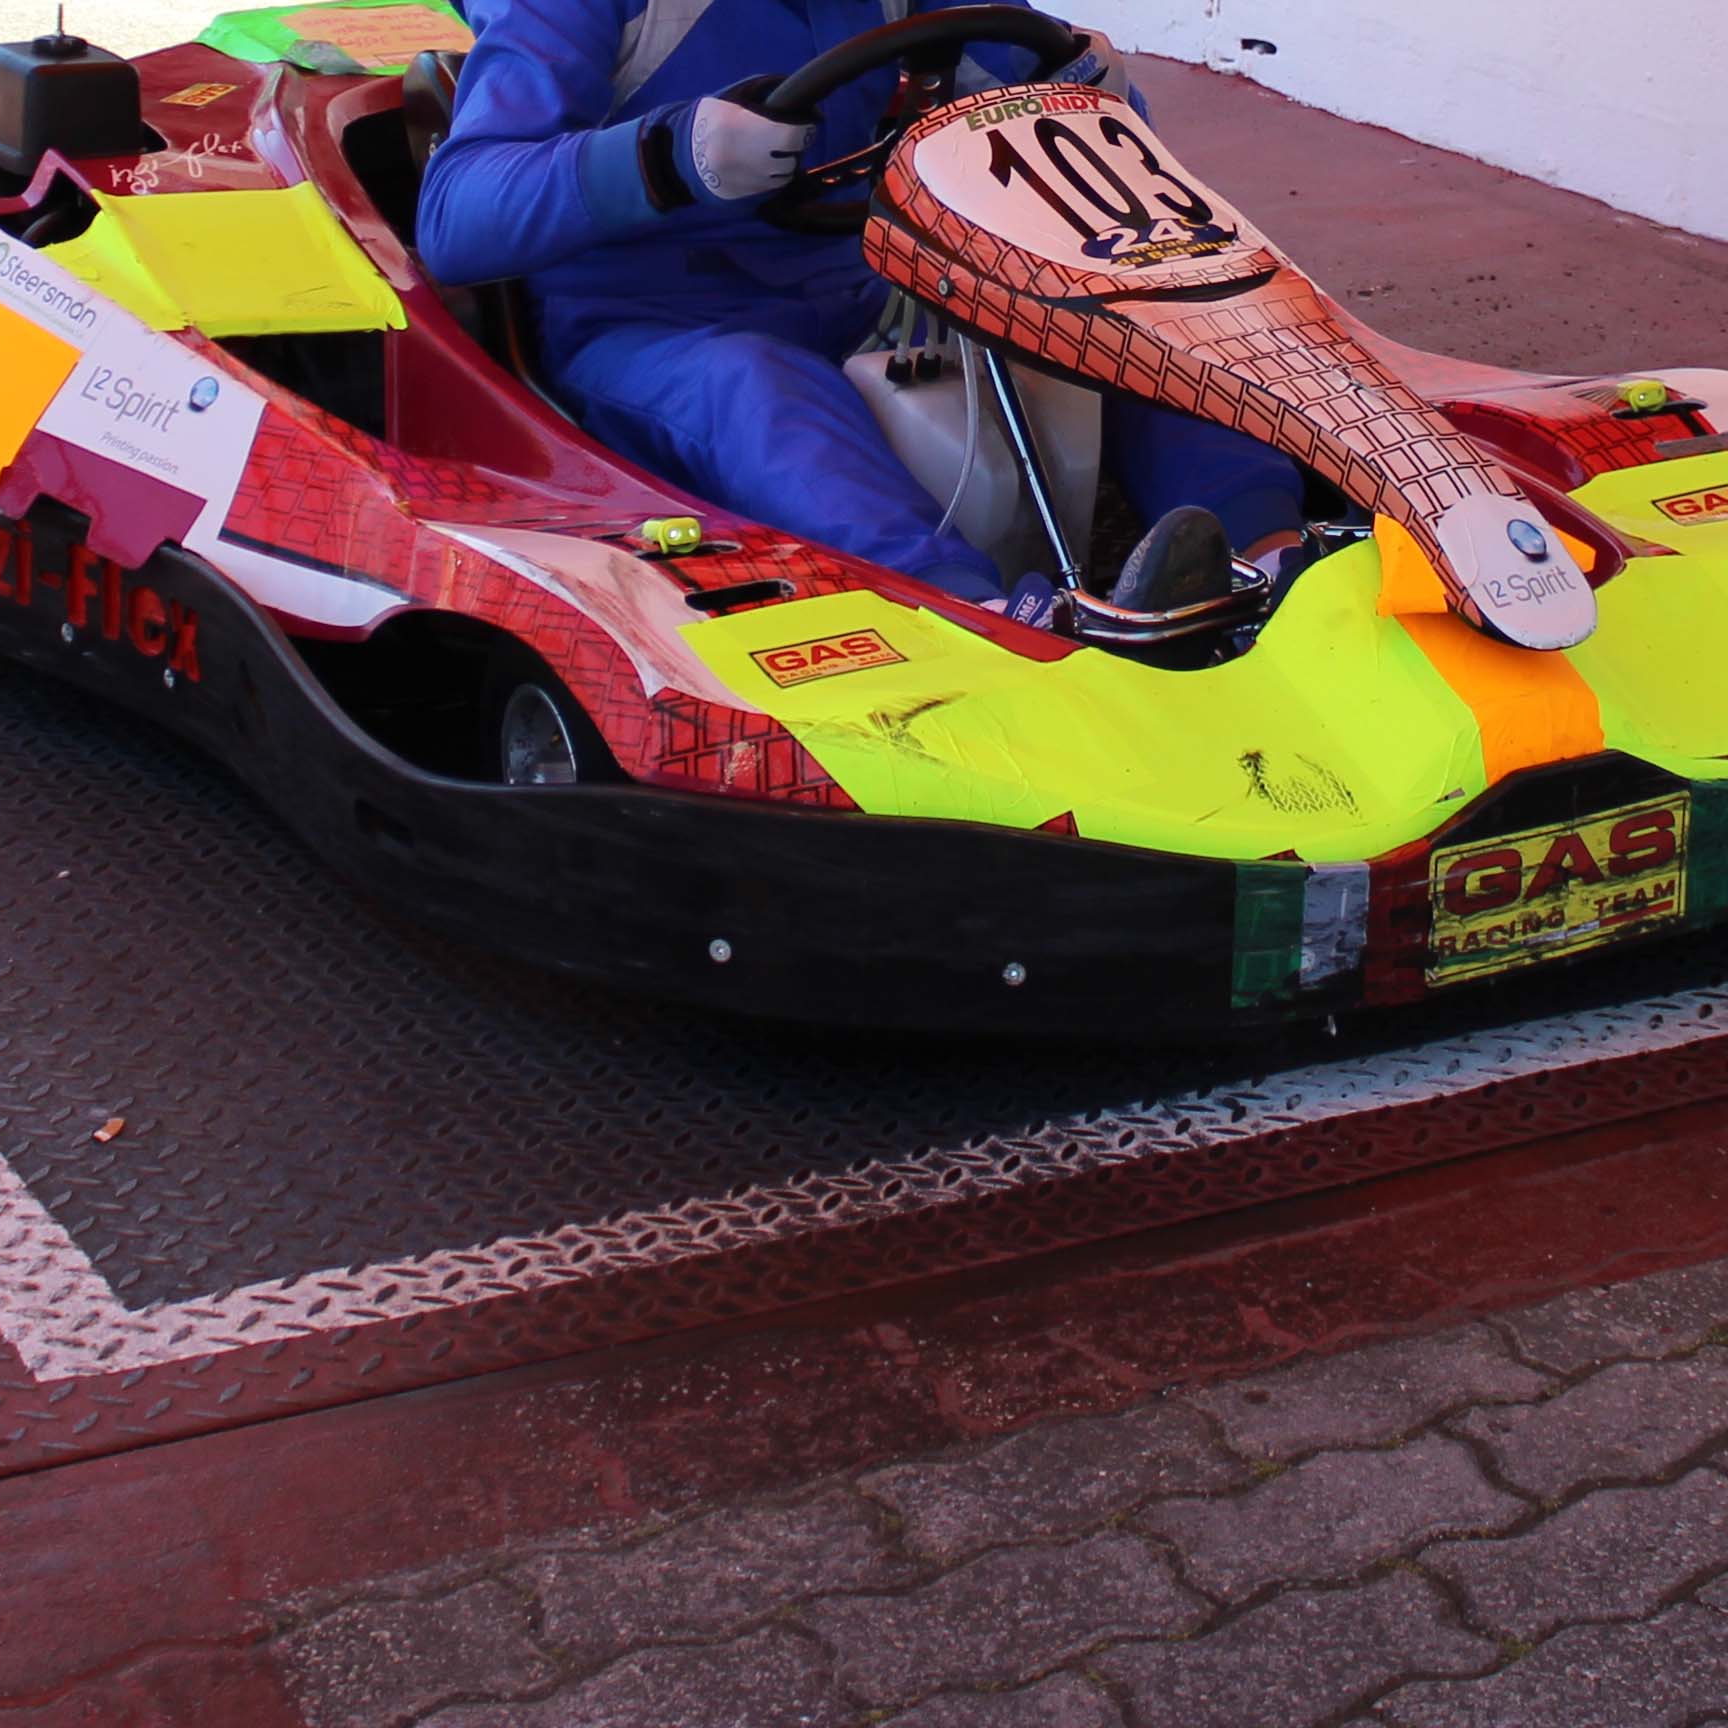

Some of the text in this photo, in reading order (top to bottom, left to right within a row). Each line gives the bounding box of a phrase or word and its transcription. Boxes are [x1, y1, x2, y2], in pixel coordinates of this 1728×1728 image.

[1062, 53, 1099, 83] OMP
[965, 94, 1102, 132] EUROINDY
[985, 116, 1214, 240] 103
[1096, 219, 1194, 255] 24
[0, 254, 98, 330] Steersman
[100, 431, 140, 460] Printing
[765, 635, 881, 673] GAS
[1444, 809, 1676, 916] GAS
[1438, 879, 1677, 957] RACING TEAM
